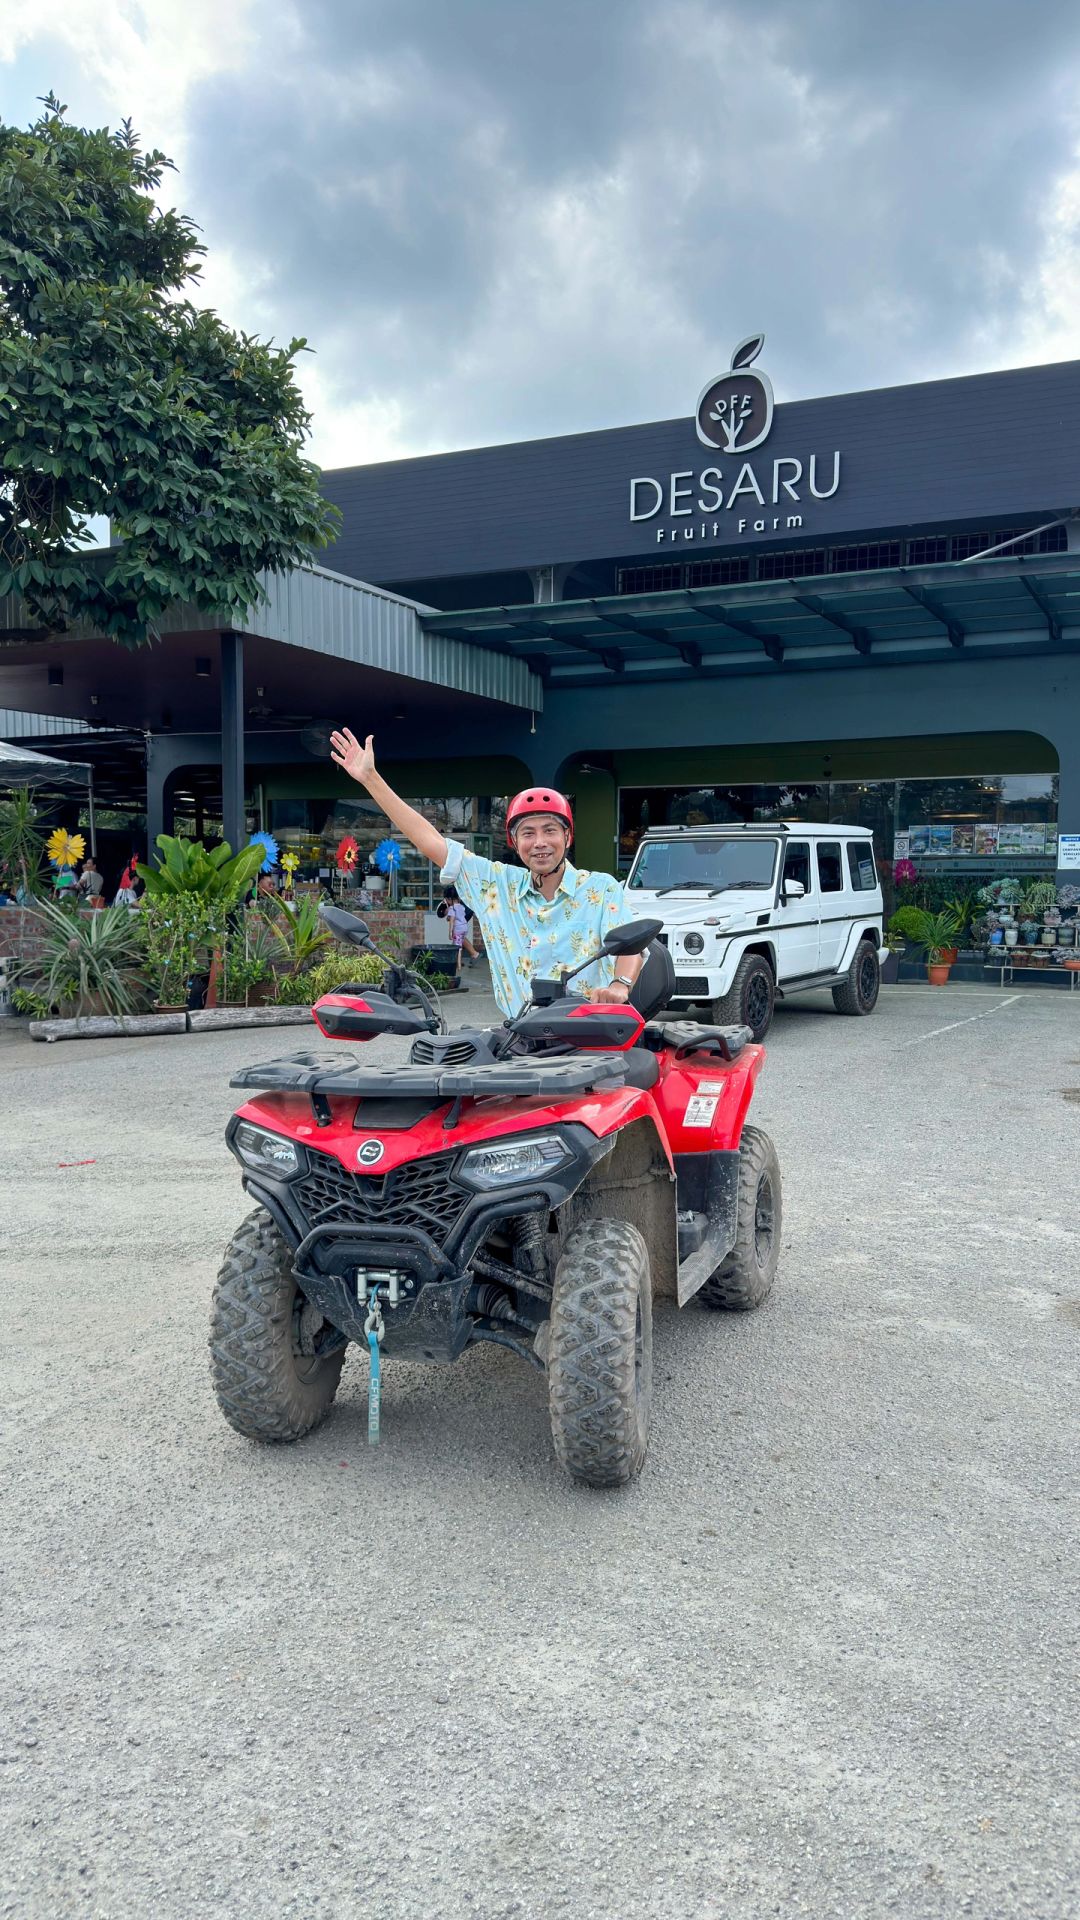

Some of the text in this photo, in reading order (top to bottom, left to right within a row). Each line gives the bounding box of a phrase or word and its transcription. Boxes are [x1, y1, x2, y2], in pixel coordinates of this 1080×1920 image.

[715, 394, 752, 414] DFF
[629, 451, 840, 521] DESARU
[656, 514, 803, 543] Fruit Farm
[370, 1378, 379, 1431] CFMOTO
